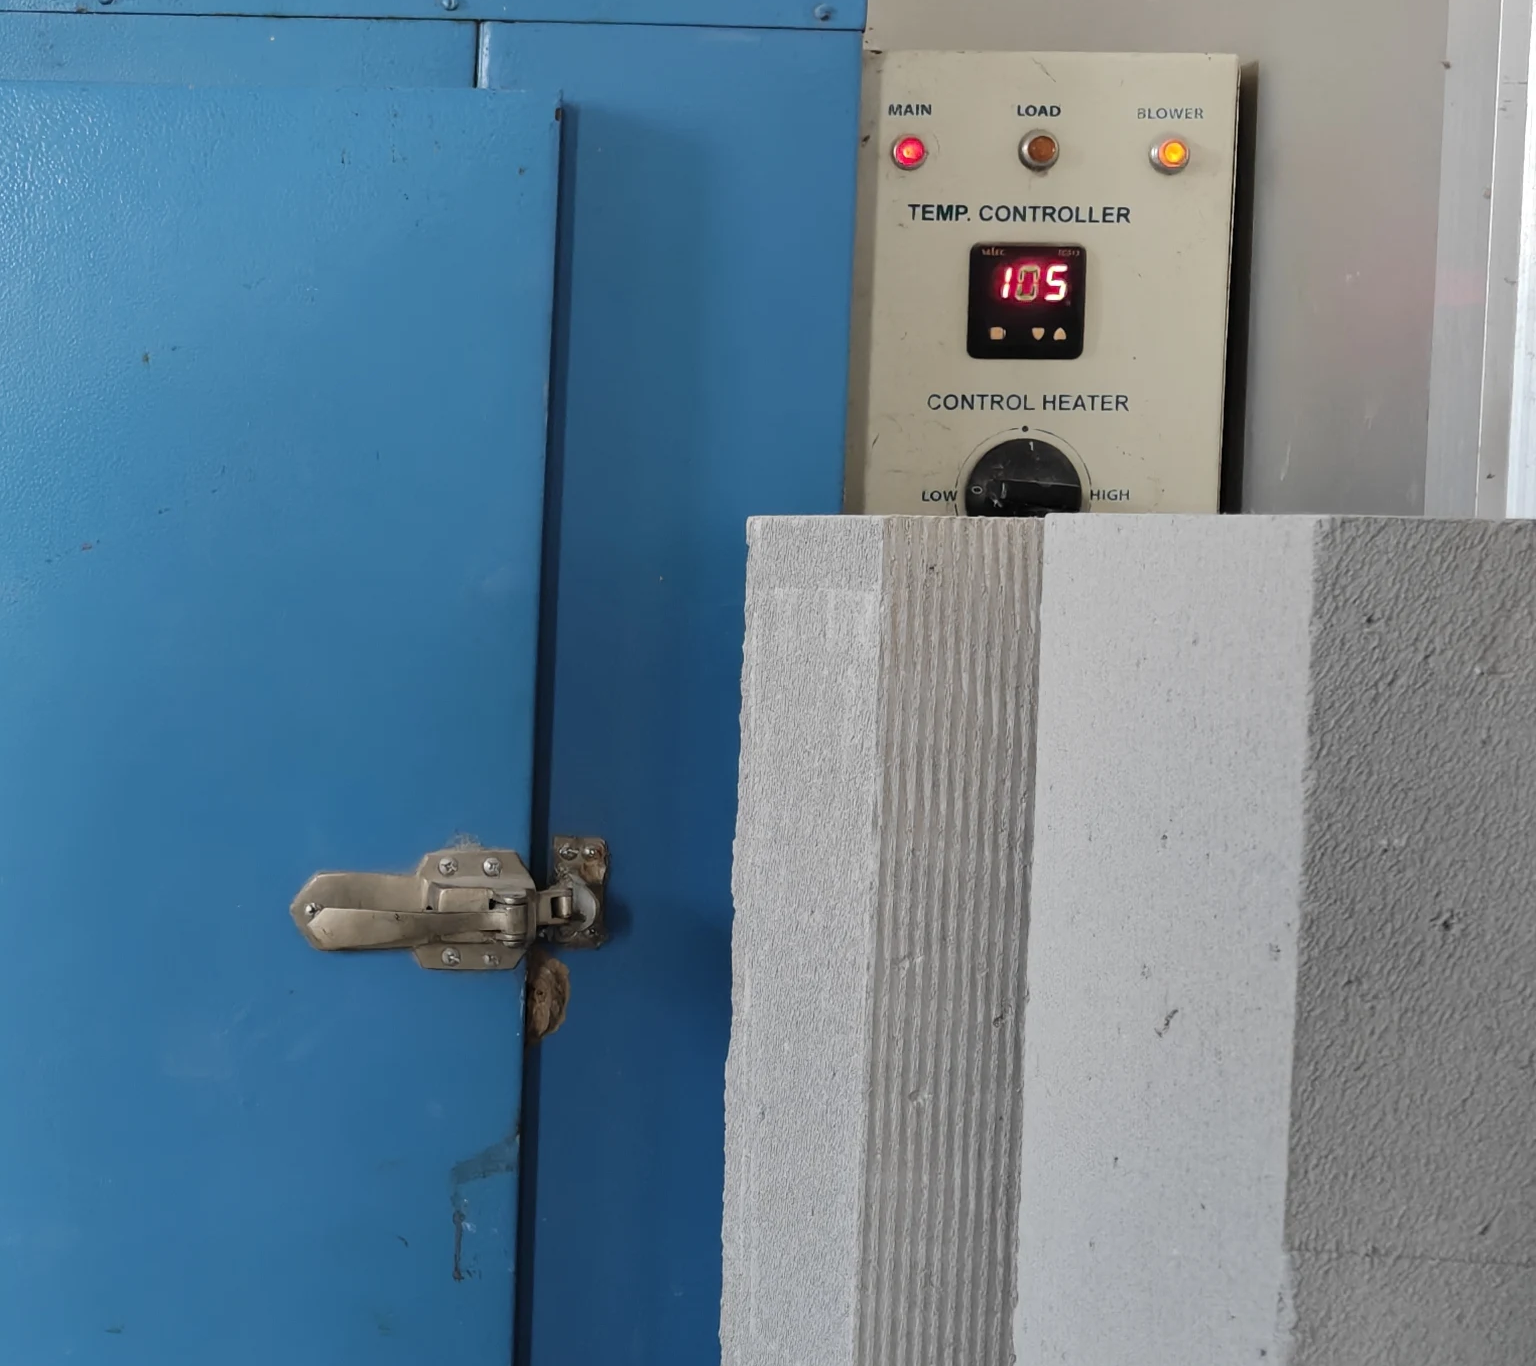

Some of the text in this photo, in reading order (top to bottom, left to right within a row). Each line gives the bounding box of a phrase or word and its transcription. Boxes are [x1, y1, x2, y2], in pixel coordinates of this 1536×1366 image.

[888, 104, 932, 116] MAIN
[1017, 105, 1061, 117] LOAD
[1137, 108, 1204, 119] BLOWER
[908, 204, 1131, 224] TEMP. CONTROLLER
[1002, 264, 1068, 301] 105
[927, 394, 1129, 411] CONTROL HEATER
[921, 490, 958, 502] LOW
[1090, 489, 1130, 501] HIGH
